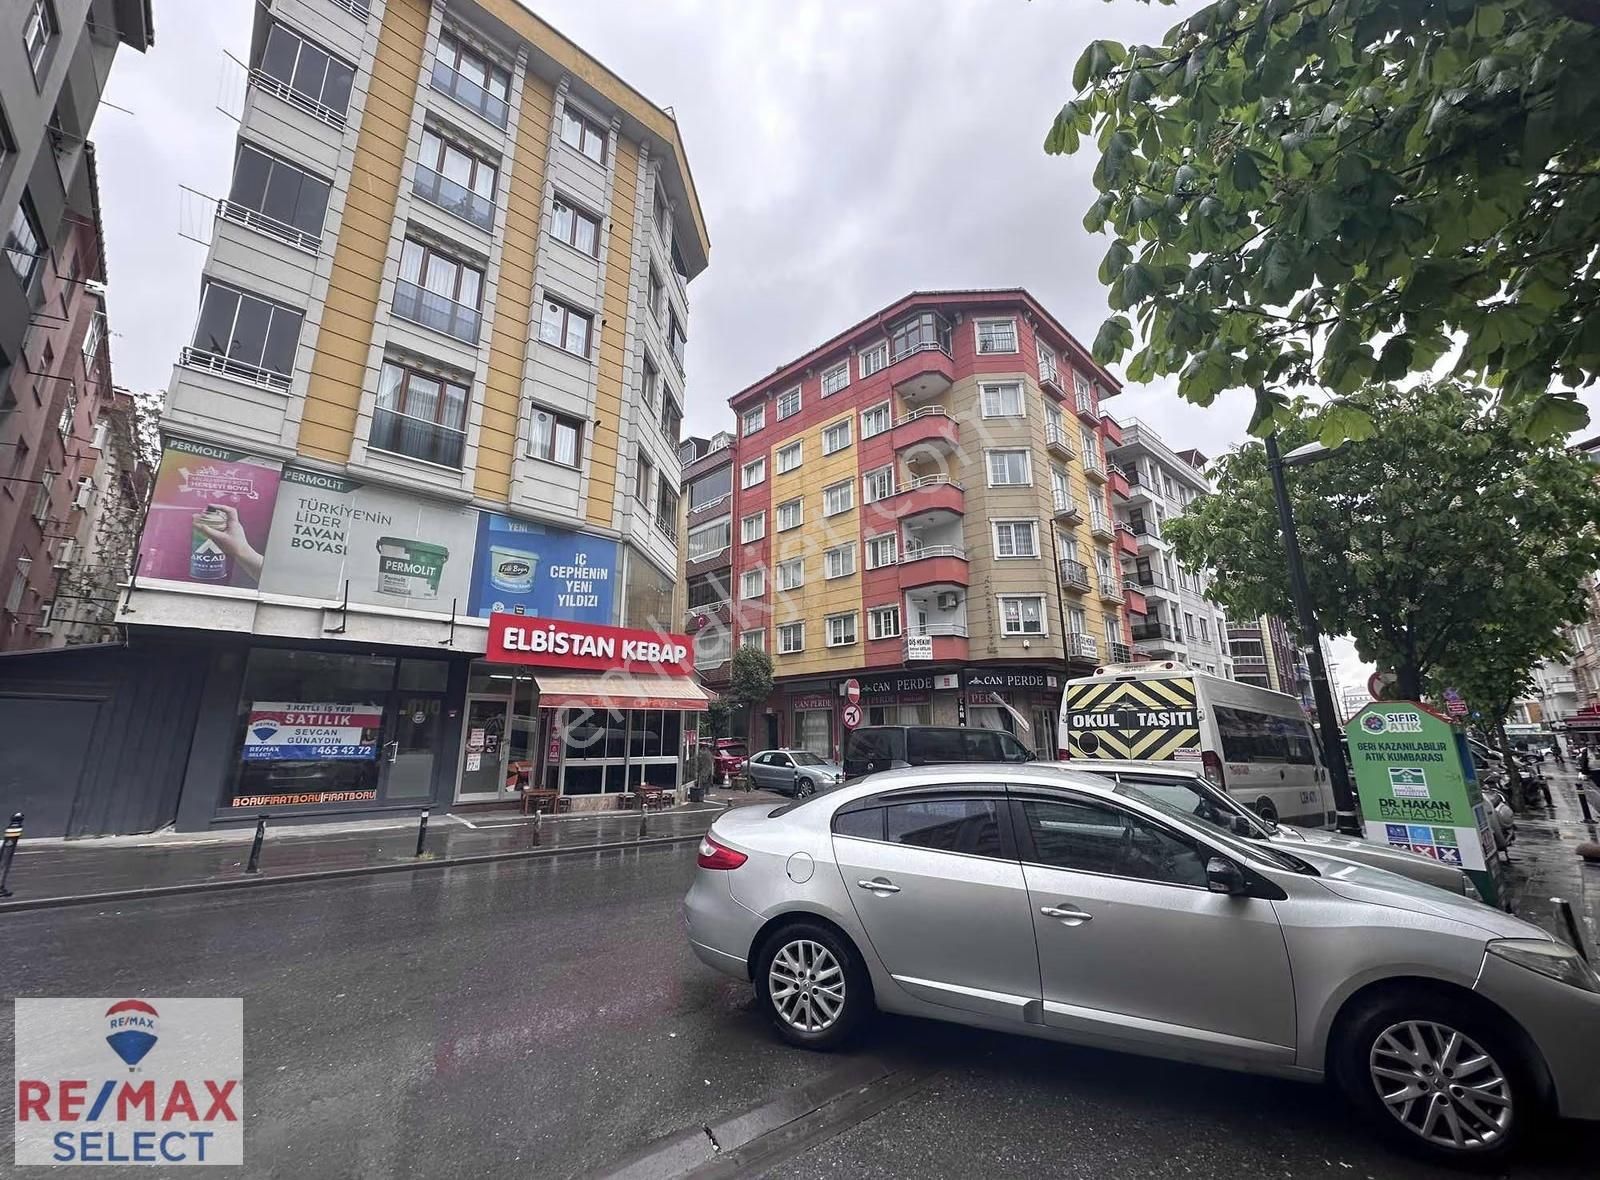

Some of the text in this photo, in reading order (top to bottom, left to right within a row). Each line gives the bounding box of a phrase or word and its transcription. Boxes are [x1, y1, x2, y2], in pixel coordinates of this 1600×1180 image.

[298, 497, 392, 526] TÜRKİYE'NİN
[296, 510, 341, 528] LİDER
[294, 524, 345, 542] TAVAN
[291, 537, 347, 555] BOYASI
[558, 594, 598, 607] YILDIZI
[503, 624, 687, 665] ELBİSTAN KEBAP
[873, 676, 932, 692] CAN PERDE
[984, 675, 1043, 686] CAN PERDE
[285, 713, 351, 726] SATILIK
[1073, 711, 1193, 728] OKUL TAŞITI
[1387, 714, 1418, 723] SIFIR
[294, 728, 338, 736] SEVCAN
[1389, 723, 1420, 733] ATIK
[317, 746, 339, 755] 465
[341, 746, 355, 755] 42
[358, 746, 371, 755] 72
[1365, 752, 1444, 762] ATIK KUMBARASI
[1403, 799, 1450, 811] HAKAN
[1380, 807, 1455, 820] BAHADIR
